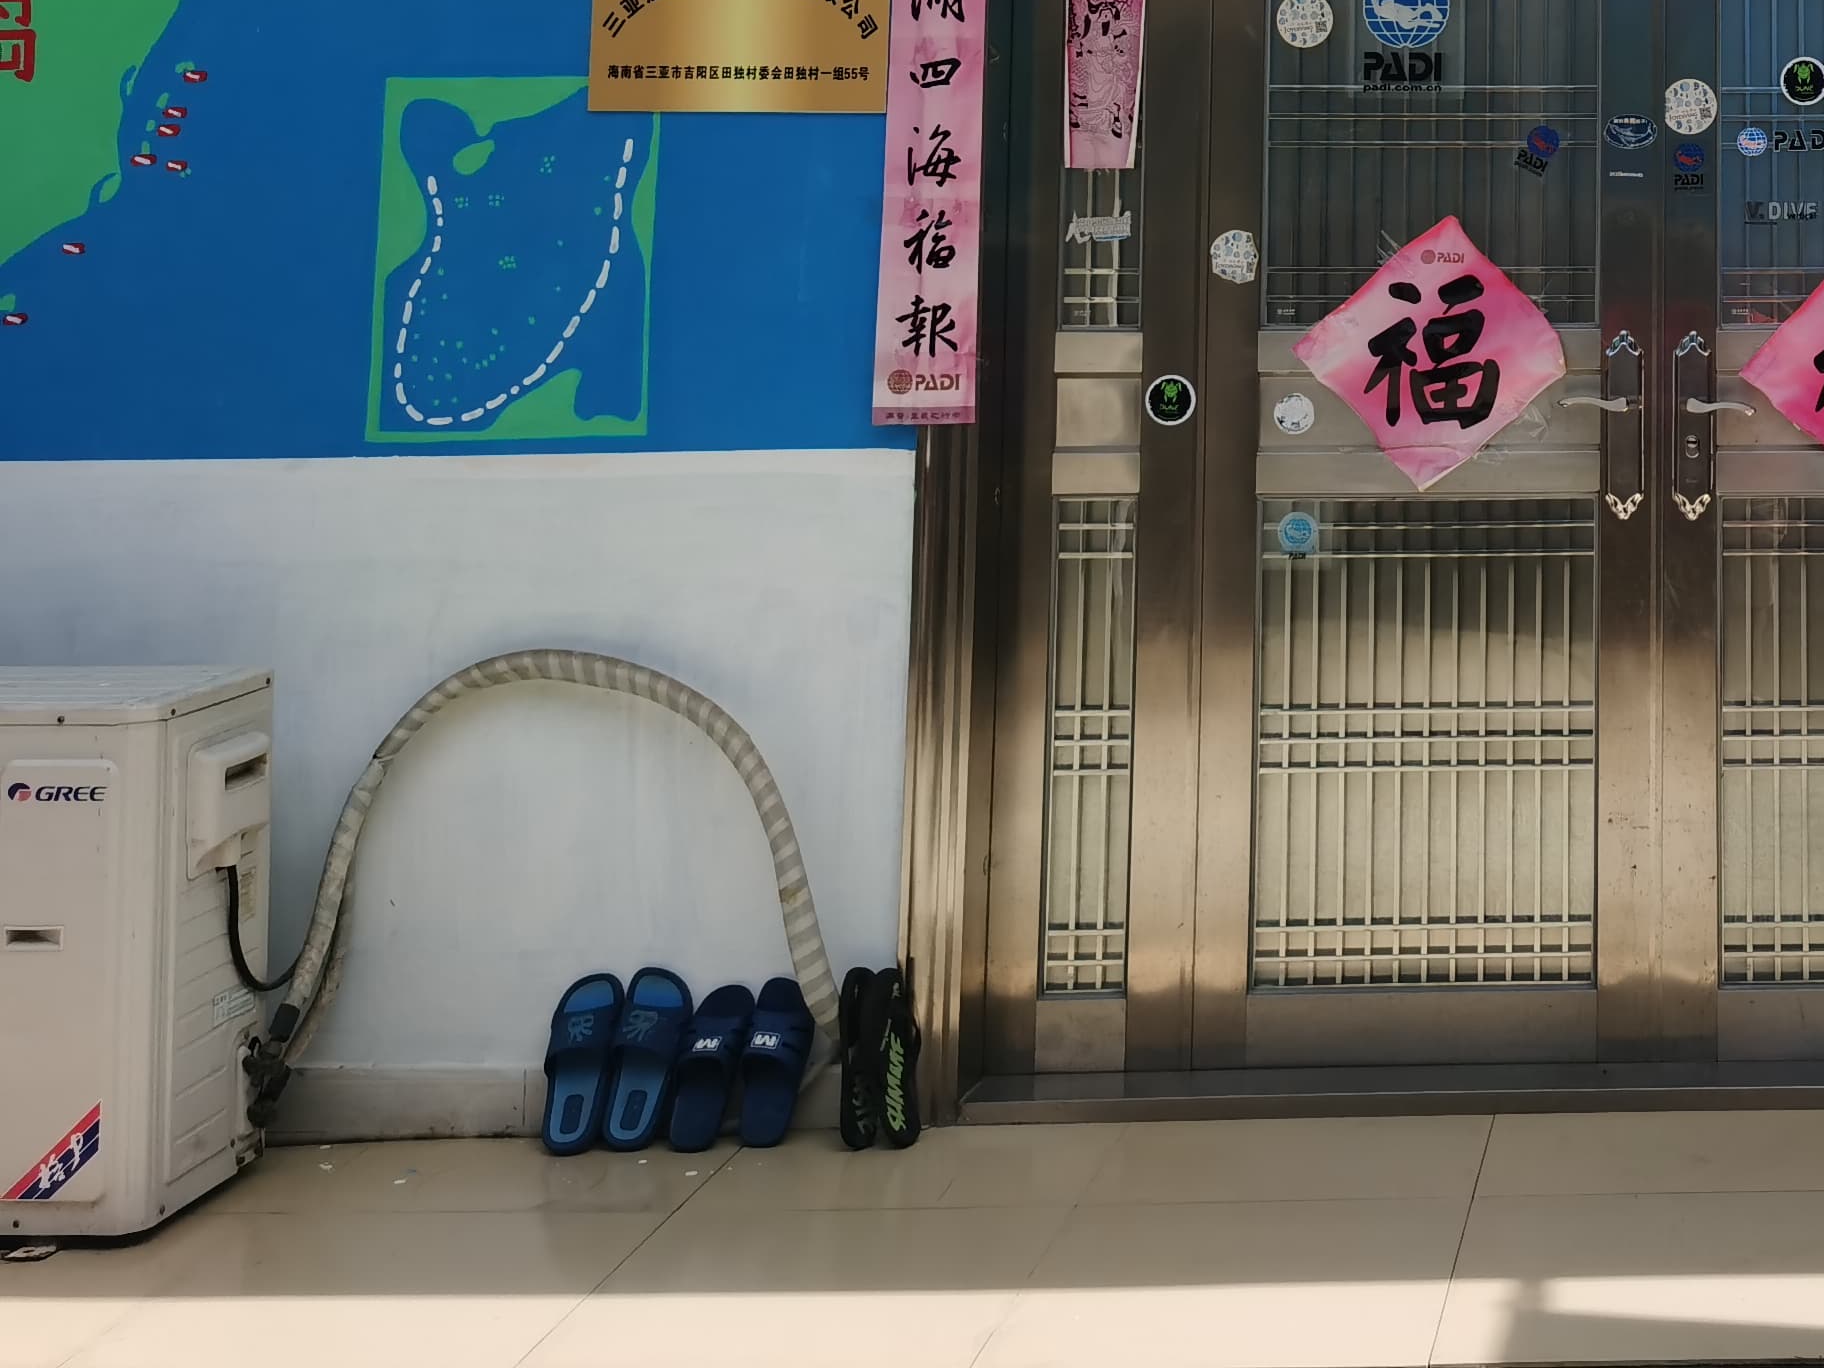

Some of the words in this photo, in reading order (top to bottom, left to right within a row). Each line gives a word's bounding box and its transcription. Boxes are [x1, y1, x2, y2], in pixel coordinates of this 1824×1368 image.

[607, 64, 871, 81] 海南省三亚市吉阳区田独村委会田独村一组55号
[1363, 52, 1442, 82] PADI
[1362, 82, 1442, 94] padi.com.cn
[1516, 148, 1549, 174] PADI
[1674, 174, 1704, 186] PADI
[1768, 202, 1818, 220] DIVE
[1436, 252, 1464, 263] PADI
[1363, 274, 1501, 429] 福
[915, 374, 961, 391] PADI
[35, 785, 108, 802] GREE
